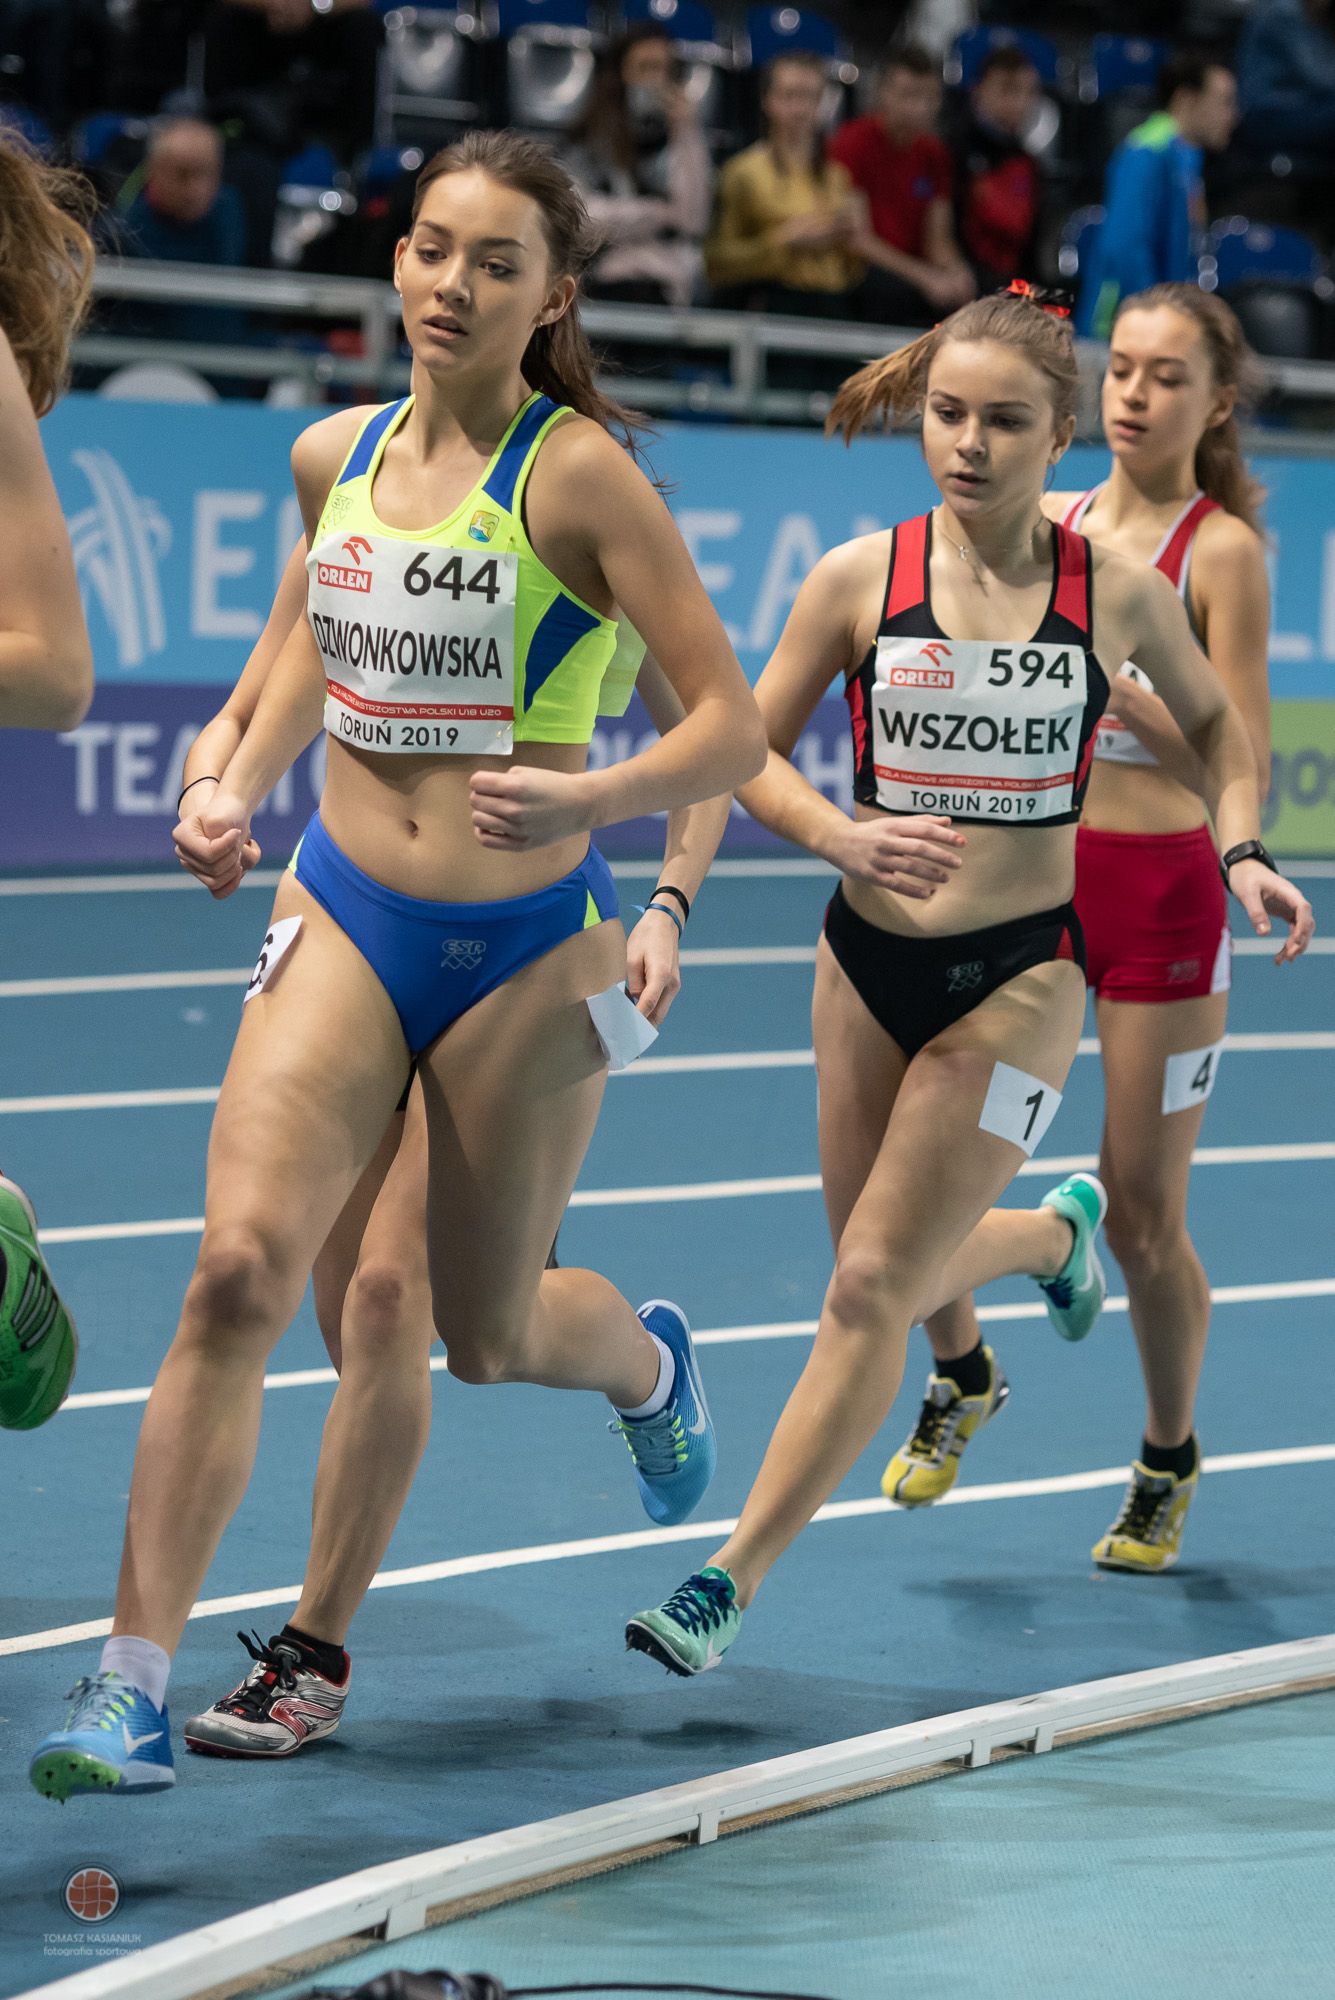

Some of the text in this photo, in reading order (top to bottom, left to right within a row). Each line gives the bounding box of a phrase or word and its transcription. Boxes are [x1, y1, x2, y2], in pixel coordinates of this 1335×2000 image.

[319, 567, 370, 591] ORLEN
[403, 551, 501, 604] 644
[312, 612, 502, 680] DZWONKOWSKA
[892, 670, 952, 687] ORLEN
[987, 648, 1074, 689] 594
[339, 711, 459, 747] TORUŃ 2019
[419, 707, 456, 716] POLSKI
[479, 708, 502, 717] U20
[878, 707, 1074, 755] WSZOŁEK
[910, 789, 1037, 815] TORUŃ 2019
[1190, 1051, 1213, 1093] 4
[1024, 1089, 1045, 1142] 1
